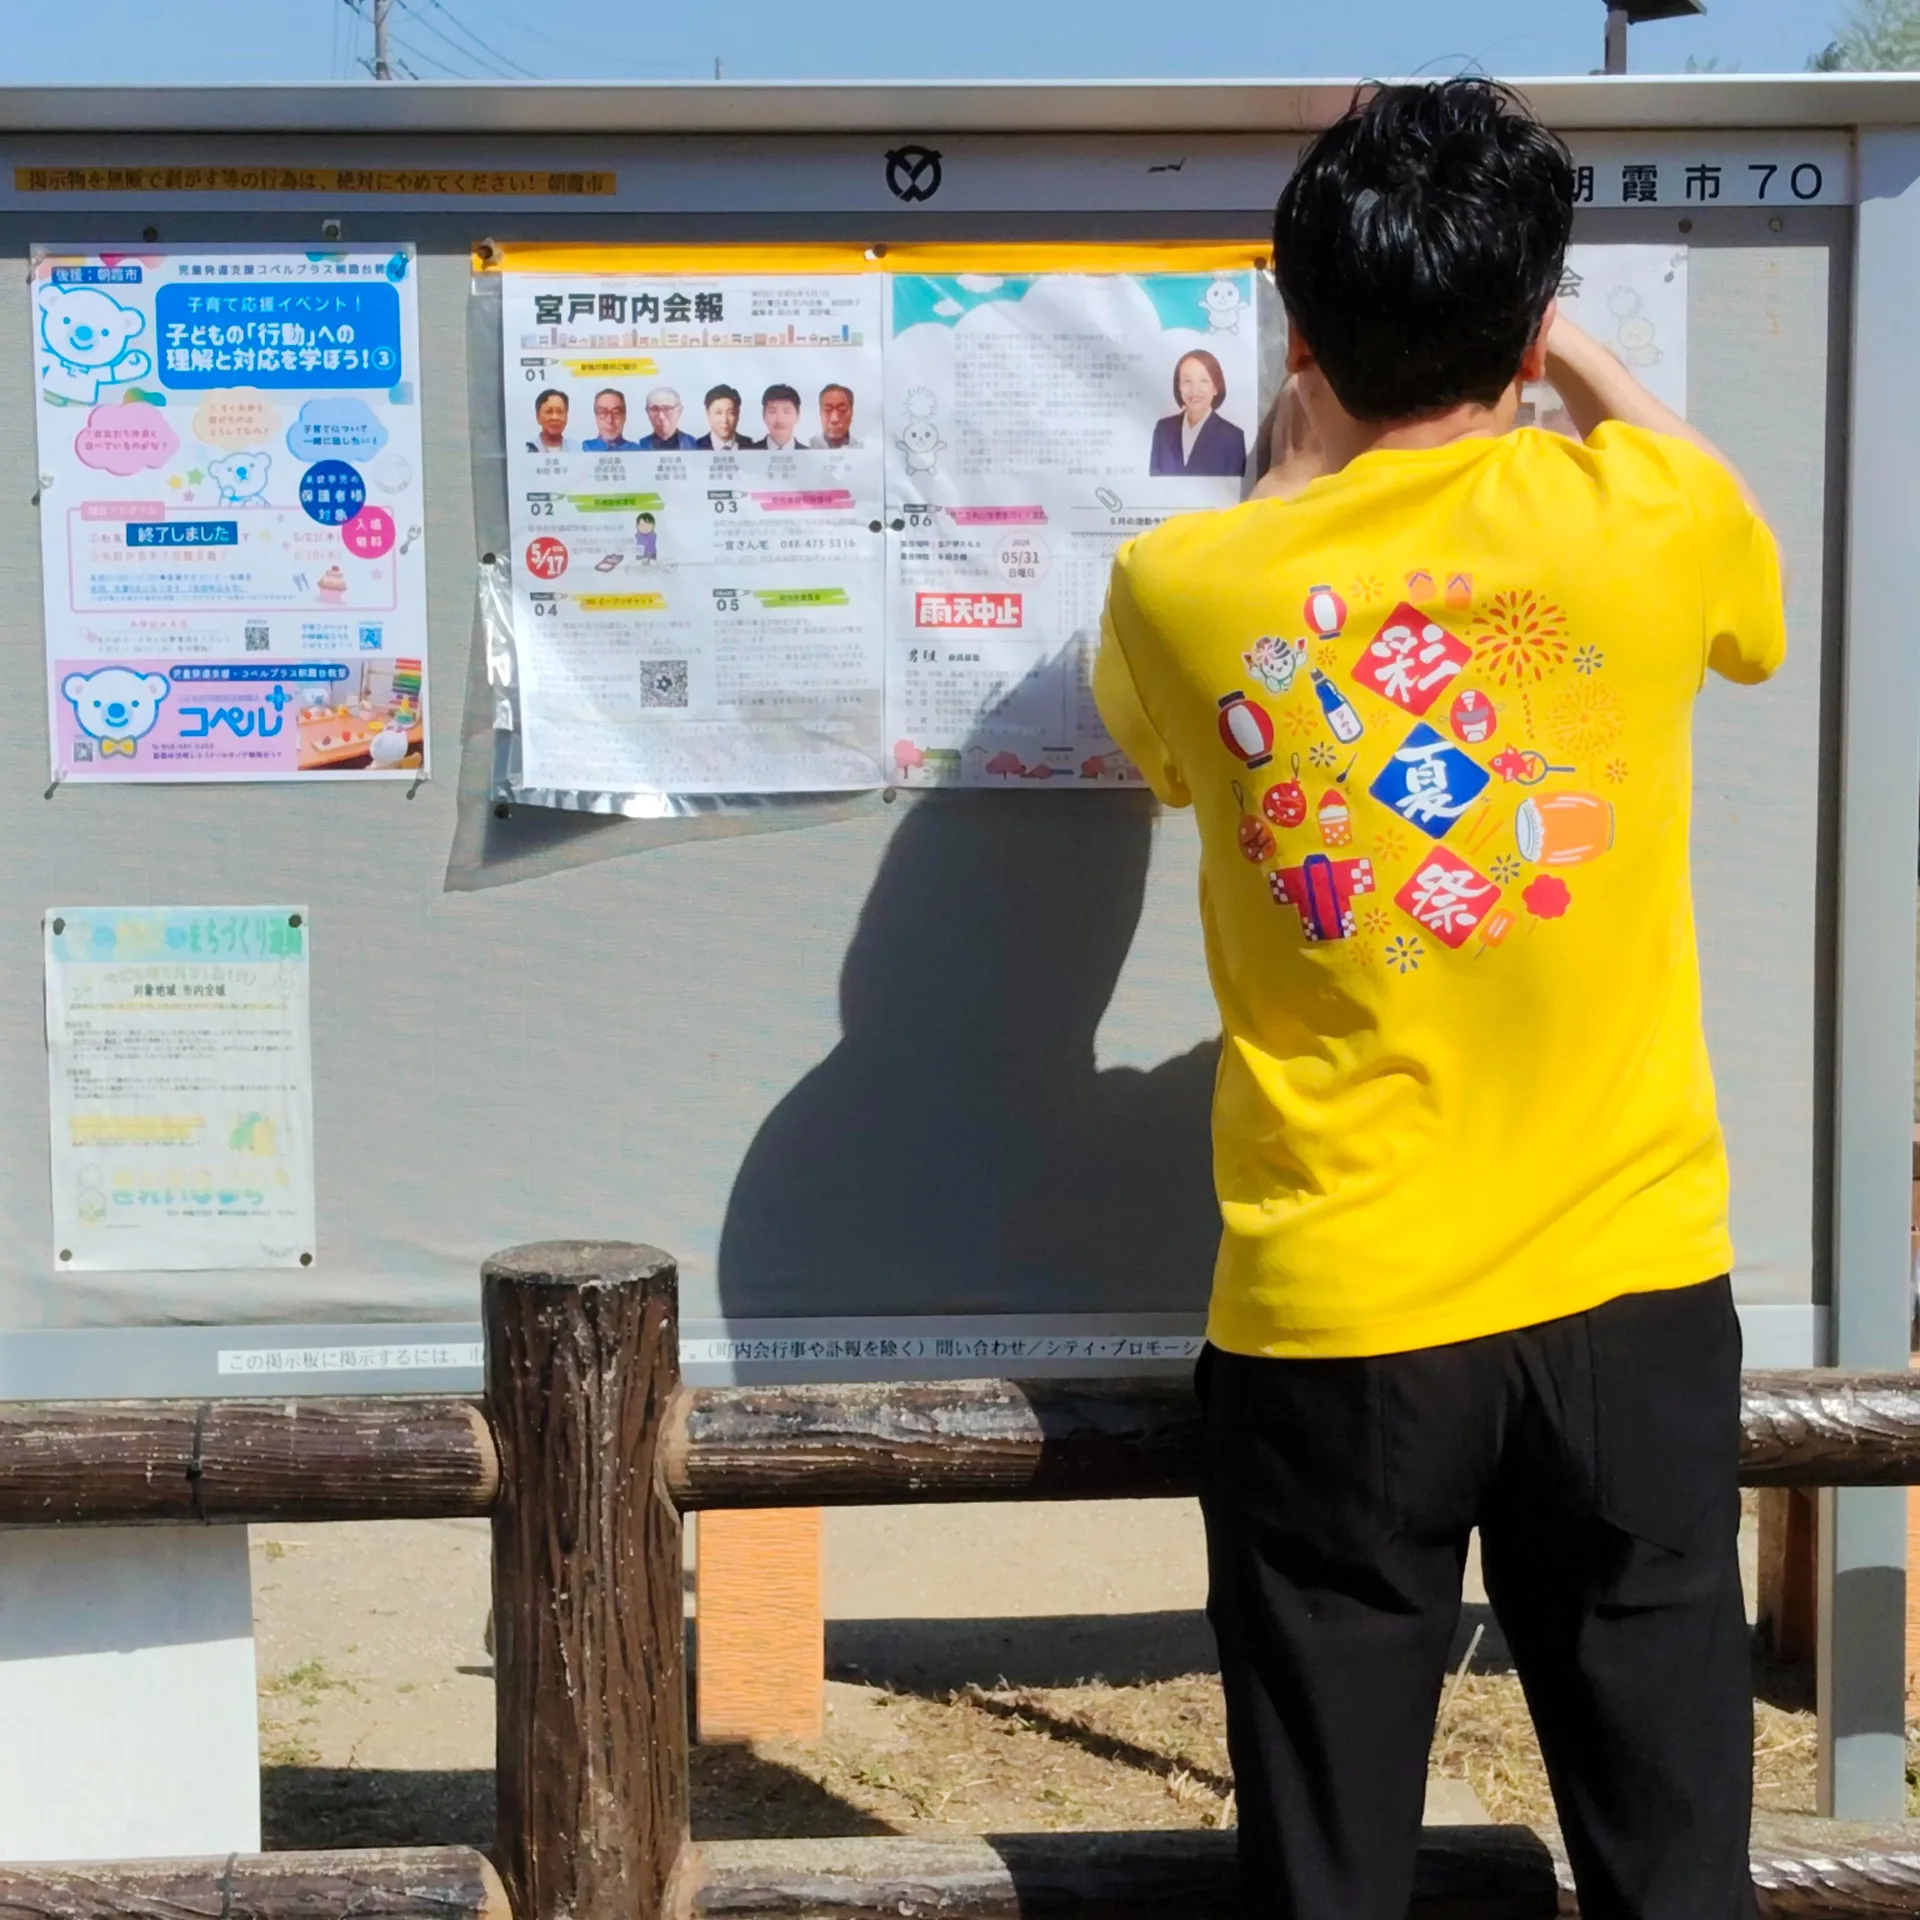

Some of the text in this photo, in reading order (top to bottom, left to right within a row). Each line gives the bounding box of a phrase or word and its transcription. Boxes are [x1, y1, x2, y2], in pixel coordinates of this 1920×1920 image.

[534, 291, 725, 325] 宮戸町内会報
[165, 322, 355, 347] 子どもの「行動」への
[530, 502, 554, 516] 02
[713, 501, 738, 514] 03
[909, 514, 932, 528] 06
[137, 526, 230, 544] 終了しました
[1001, 551, 1041, 565] 05/31
[534, 603, 558, 617] 04
[716, 599, 740, 611] 05
[919, 596, 1020, 626] 雨天中止
